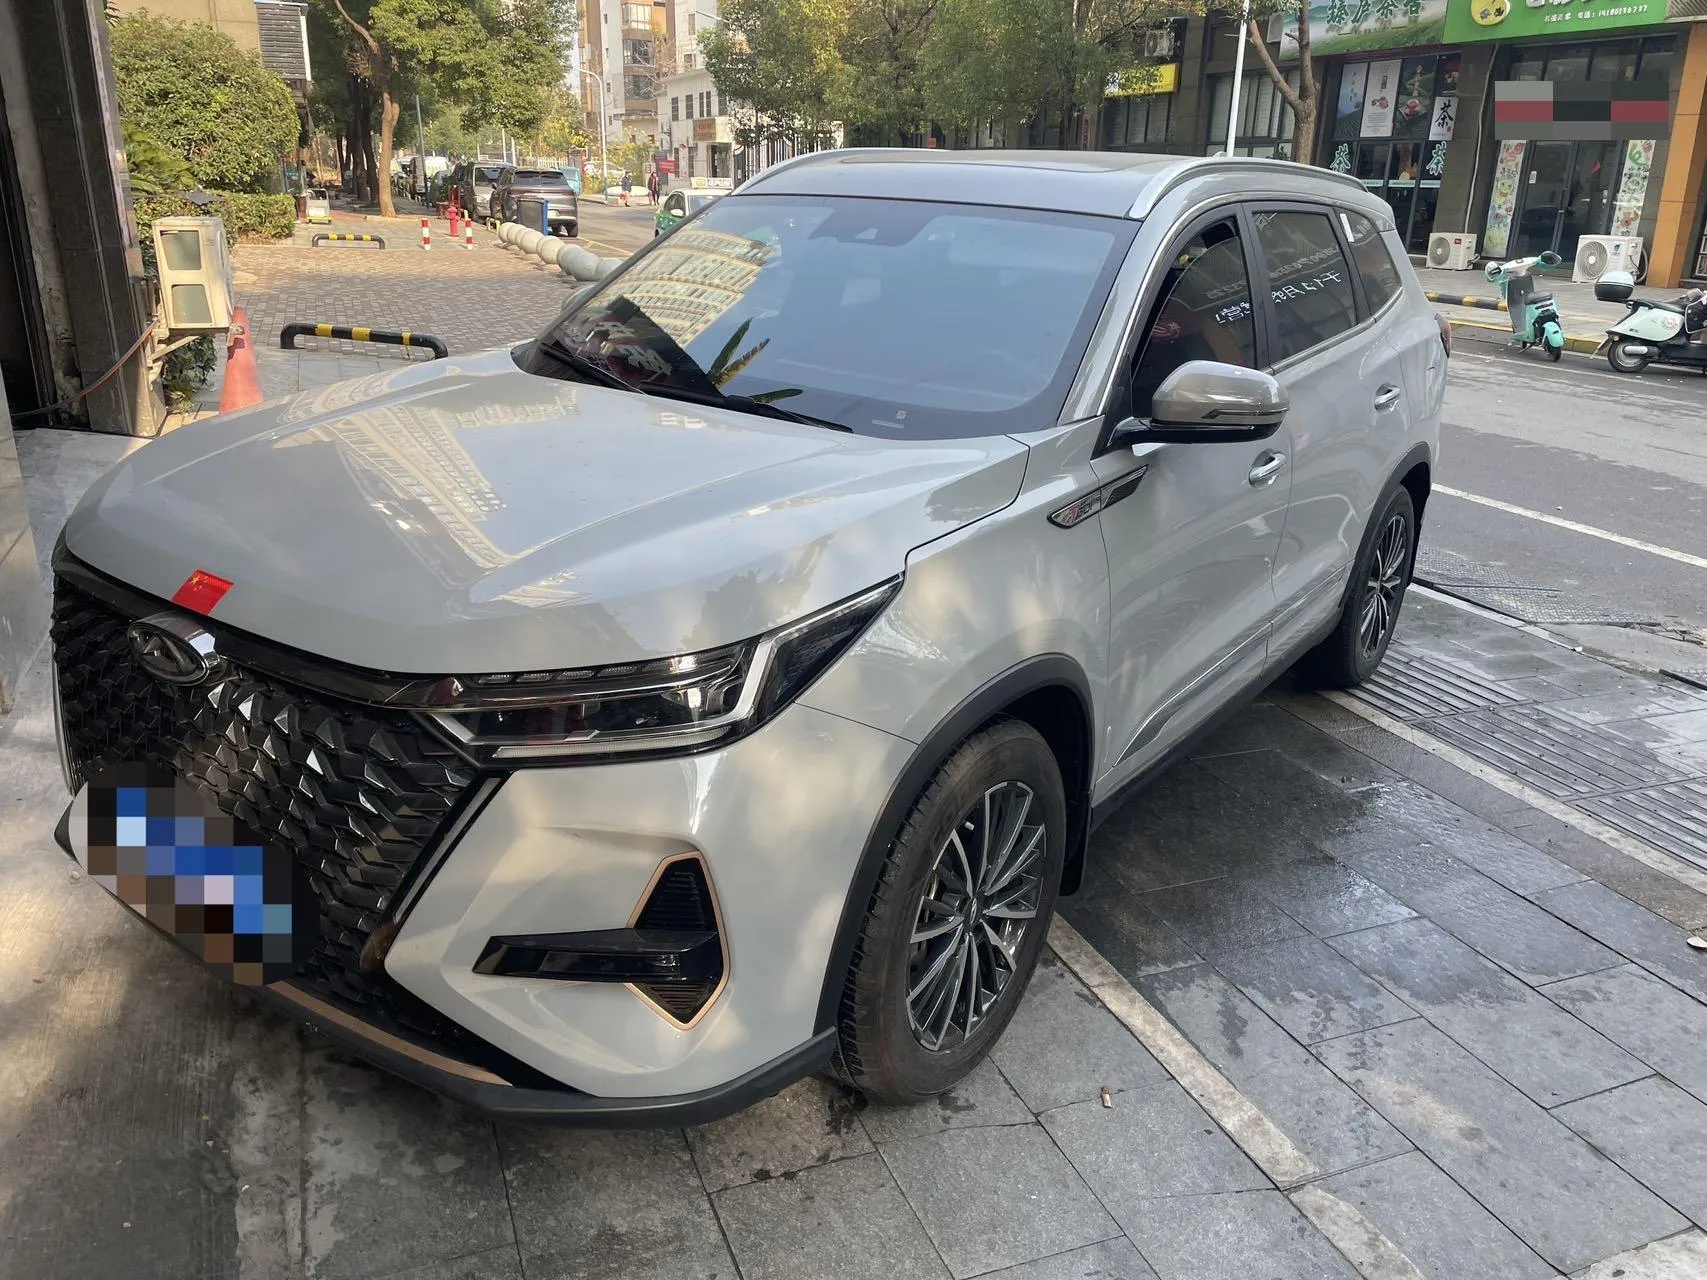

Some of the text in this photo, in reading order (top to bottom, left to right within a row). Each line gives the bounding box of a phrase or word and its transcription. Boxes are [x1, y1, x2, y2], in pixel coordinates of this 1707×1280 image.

[1434, 99, 1455, 128] 茶
[1330, 143, 1351, 173] 茶
[1426, 141, 1447, 176] 茶
